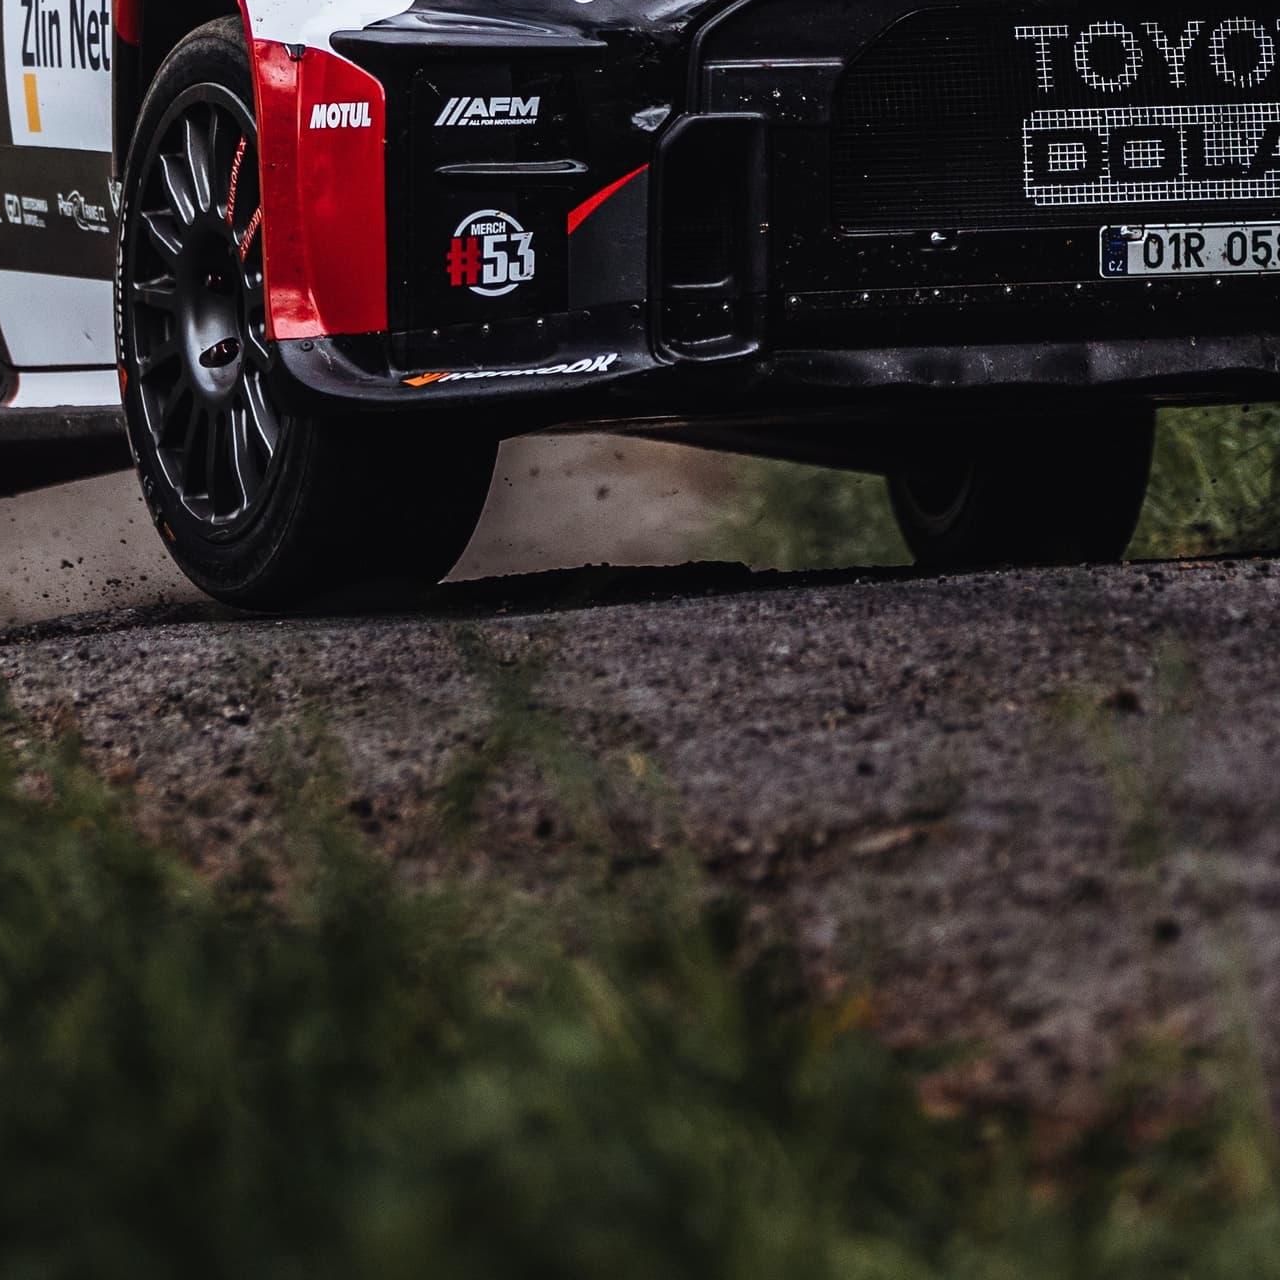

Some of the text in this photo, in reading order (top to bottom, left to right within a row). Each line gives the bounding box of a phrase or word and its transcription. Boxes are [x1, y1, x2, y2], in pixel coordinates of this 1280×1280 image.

[309, 101, 372, 130] MOTUL
[470, 221, 507, 237] MERCH
[446, 231, 536, 287] #53
[1107, 259, 1124, 273] CZ
